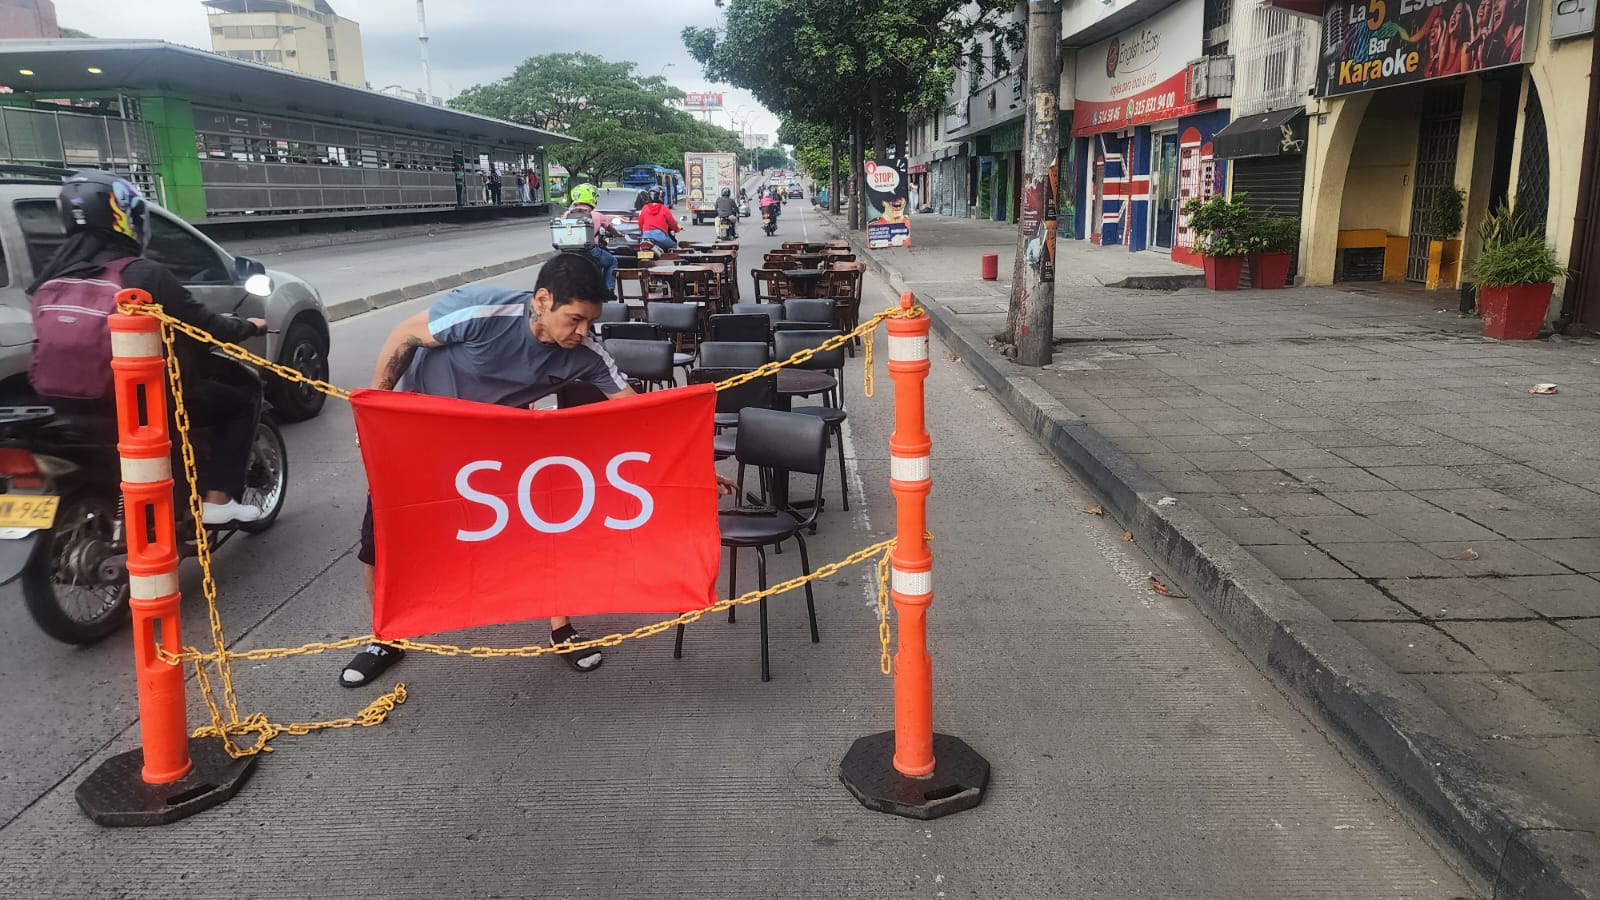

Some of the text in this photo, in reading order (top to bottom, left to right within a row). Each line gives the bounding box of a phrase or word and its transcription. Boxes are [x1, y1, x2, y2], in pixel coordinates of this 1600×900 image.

[1349, 3, 1366, 24] La
[1368, 0, 1385, 30] 5
[1146, 30, 1161, 54] Easy
[1369, 37, 1390, 55] Bar
[1338, 48, 1419, 86] Karaoke
[1134, 99, 1145, 115] 315
[1145, 96, 1156, 113] 831
[1157, 94, 1166, 110] 94
[1166, 91, 1175, 109] 00
[874, 171, 894, 183] STOP!
[455, 451, 654, 542] SOS
